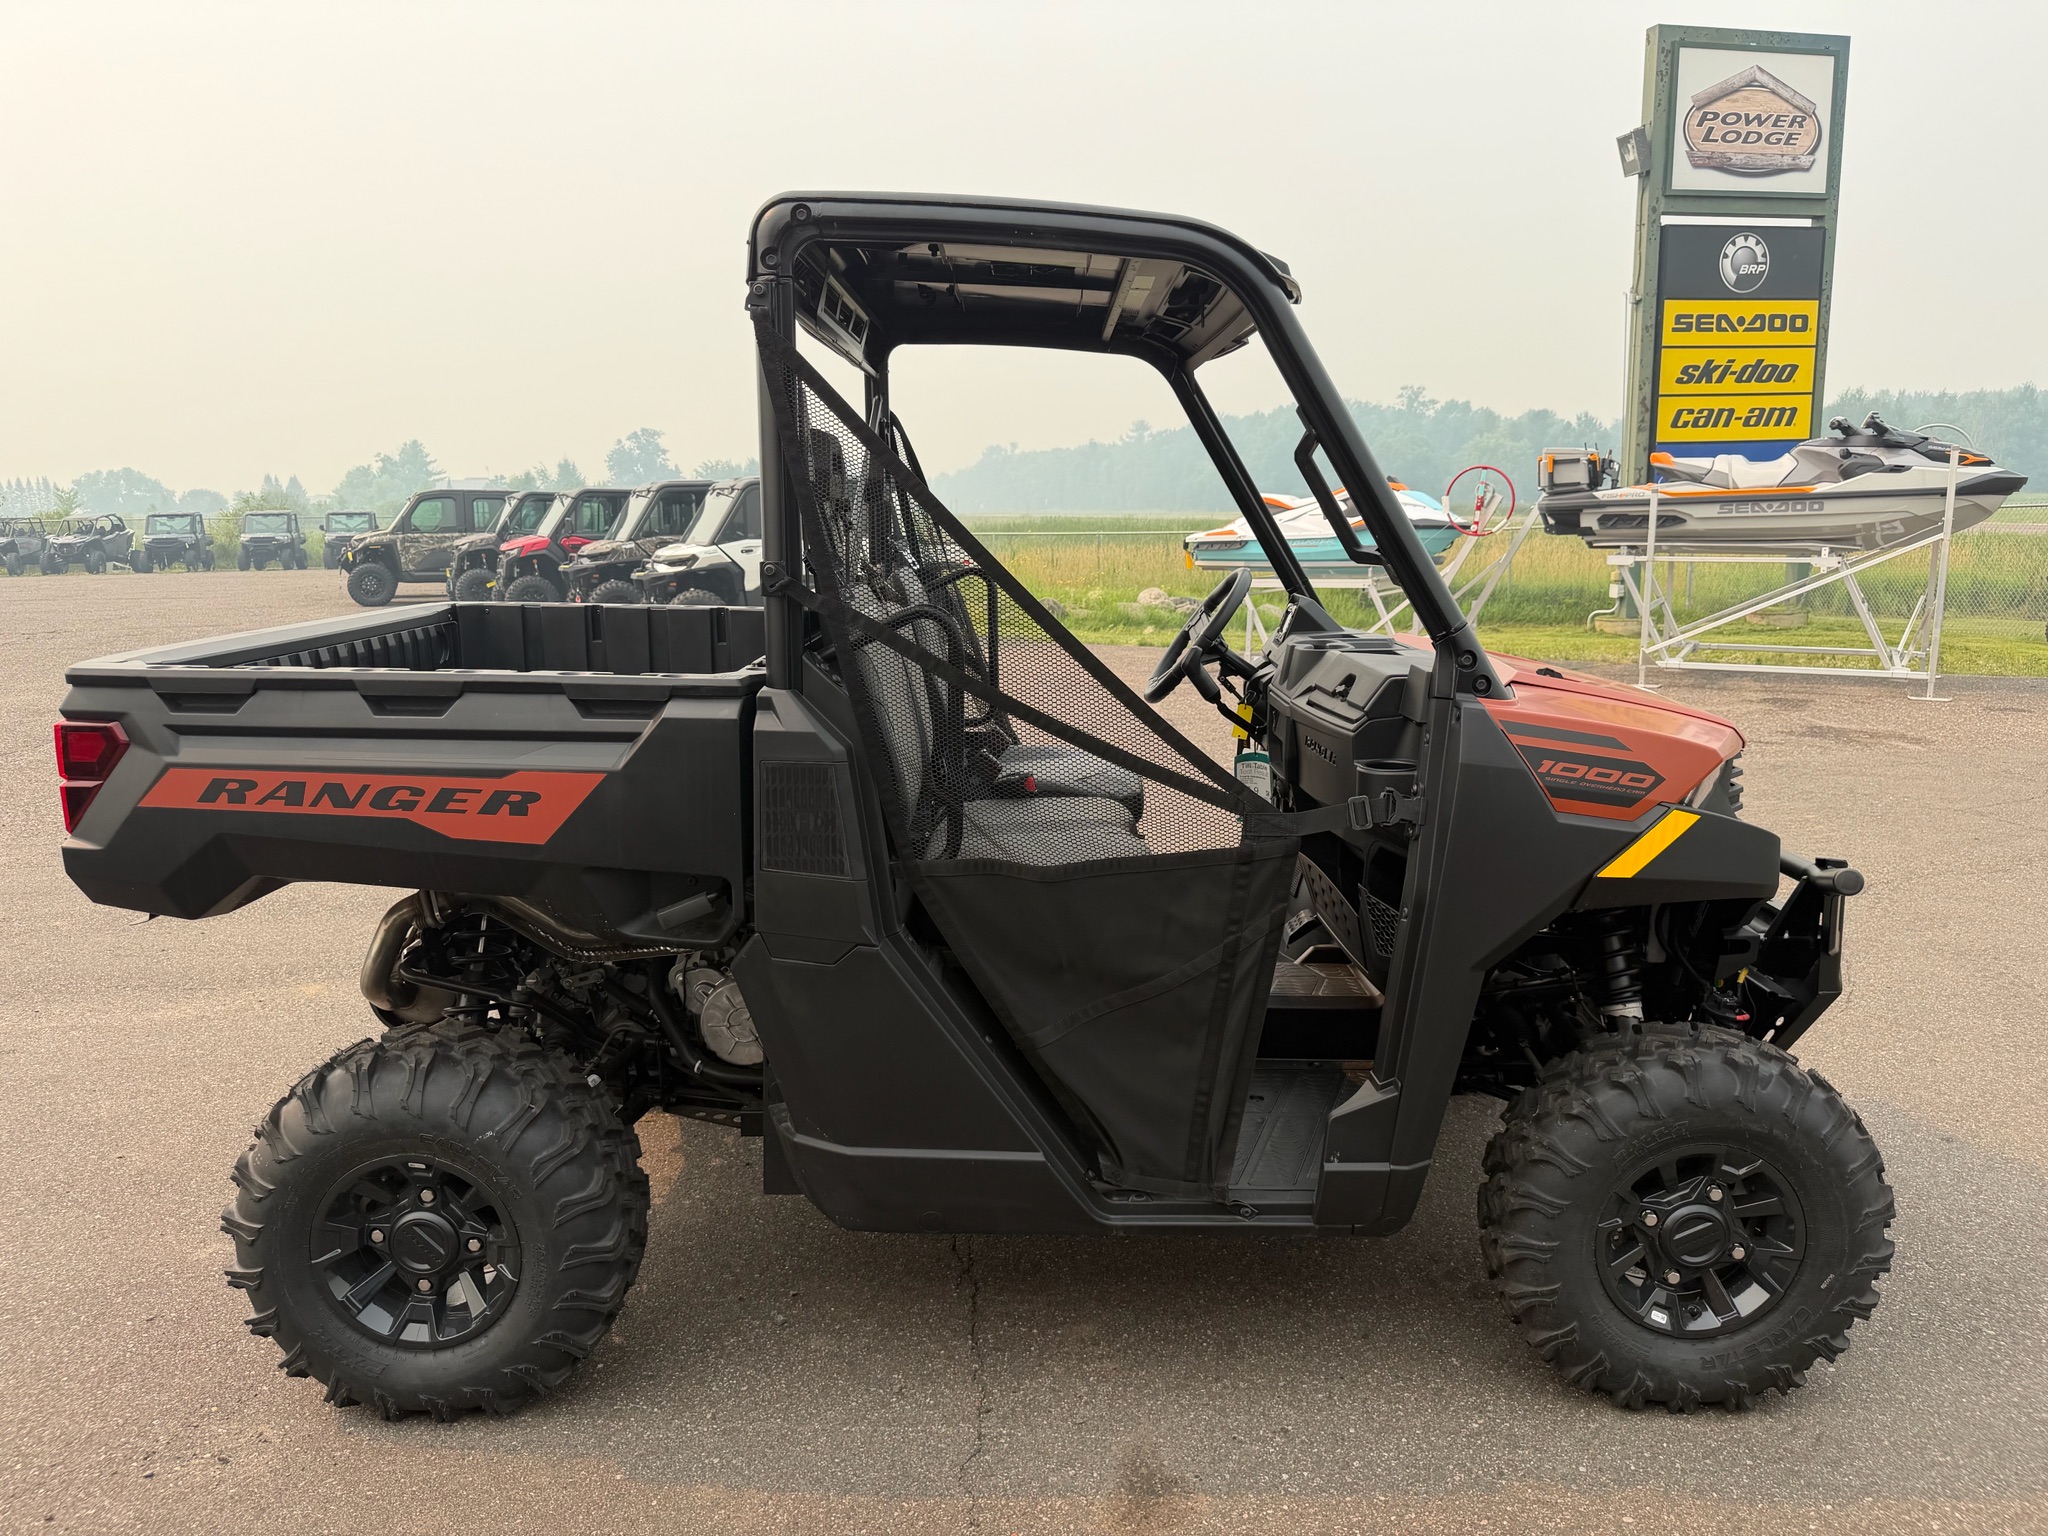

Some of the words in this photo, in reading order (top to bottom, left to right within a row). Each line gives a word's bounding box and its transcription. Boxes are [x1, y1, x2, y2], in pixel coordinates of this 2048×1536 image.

[1695, 110, 1808, 129] POWER
[1700, 126, 1802, 146] LODGE
[1739, 264, 1767, 275] BRP
[1674, 358, 1800, 385] ski-doo
[1670, 406, 1798, 429] can-am
[1538, 760, 1656, 789] 1000
[1544, 777, 1577, 785] SINGLE
[1579, 780, 1626, 793] OVERHEAD
[196, 777, 542, 816] RANGER
